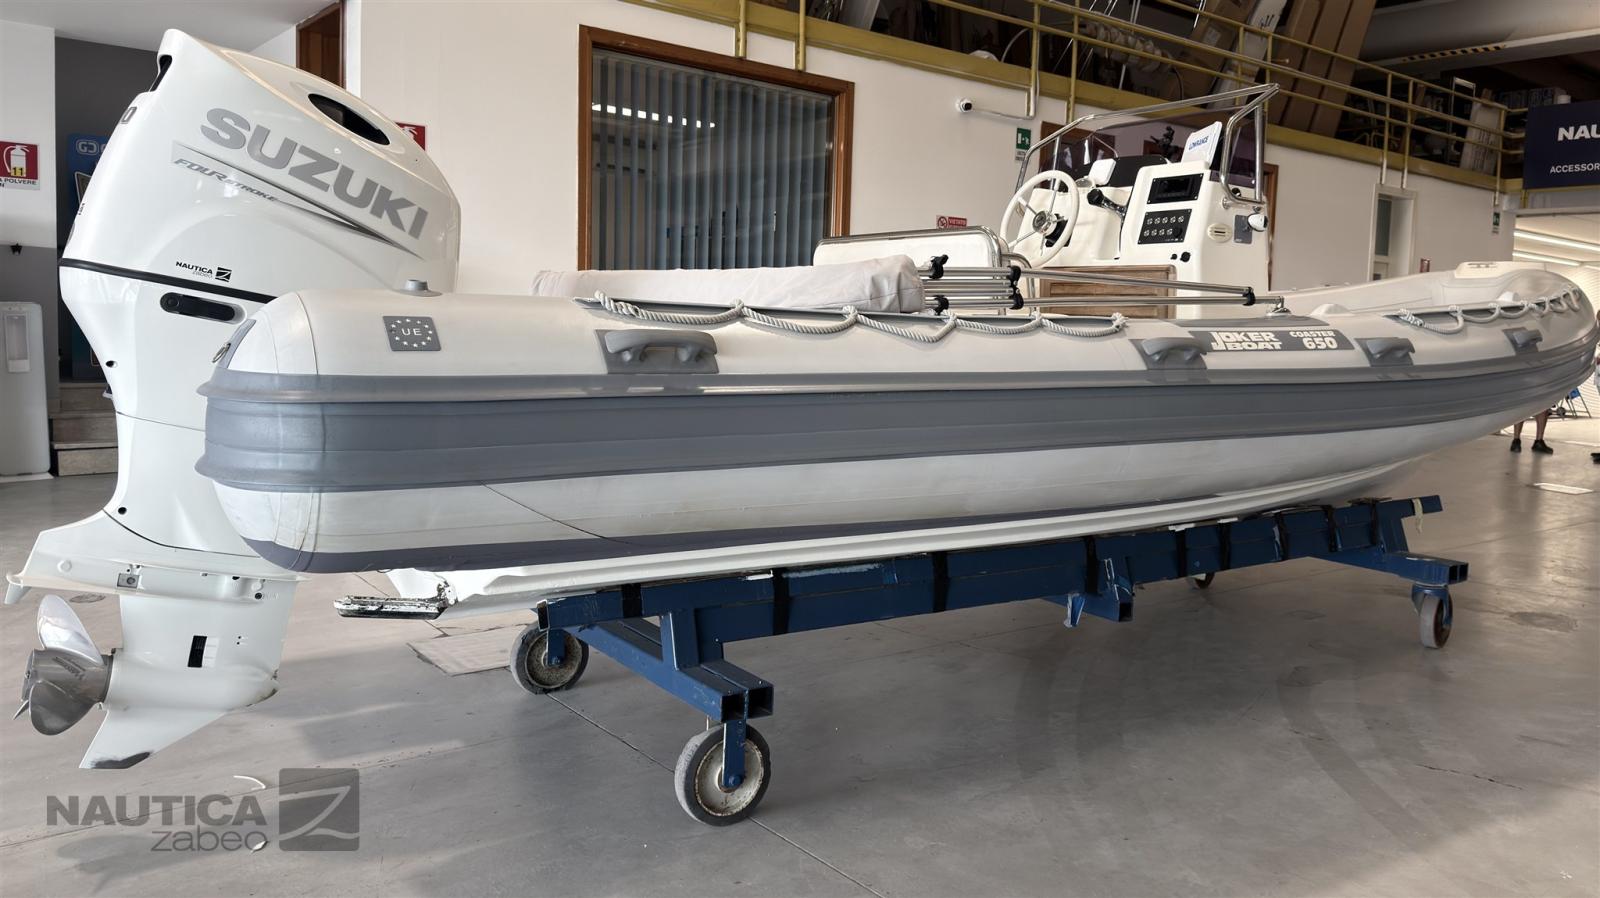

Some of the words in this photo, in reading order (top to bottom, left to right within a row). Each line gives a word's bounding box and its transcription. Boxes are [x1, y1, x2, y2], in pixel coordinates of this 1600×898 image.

[1557, 124, 1600, 141] NAU
[12, 167, 24, 176] 11
[200, 107, 429, 240] SUZUKI
[1549, 163, 1600, 174] ACCESSOR
[4, 177, 37, 186] POLVERE
[174, 158, 228, 181] FOUR
[224, 179, 279, 201] STROKE
[175, 261, 213, 275] NAUTICA
[401, 328, 422, 336] UE
[1210, 331, 1279, 350] JOKER
[1225, 342, 1282, 351] BOAT
[1302, 337, 1338, 350] 650
